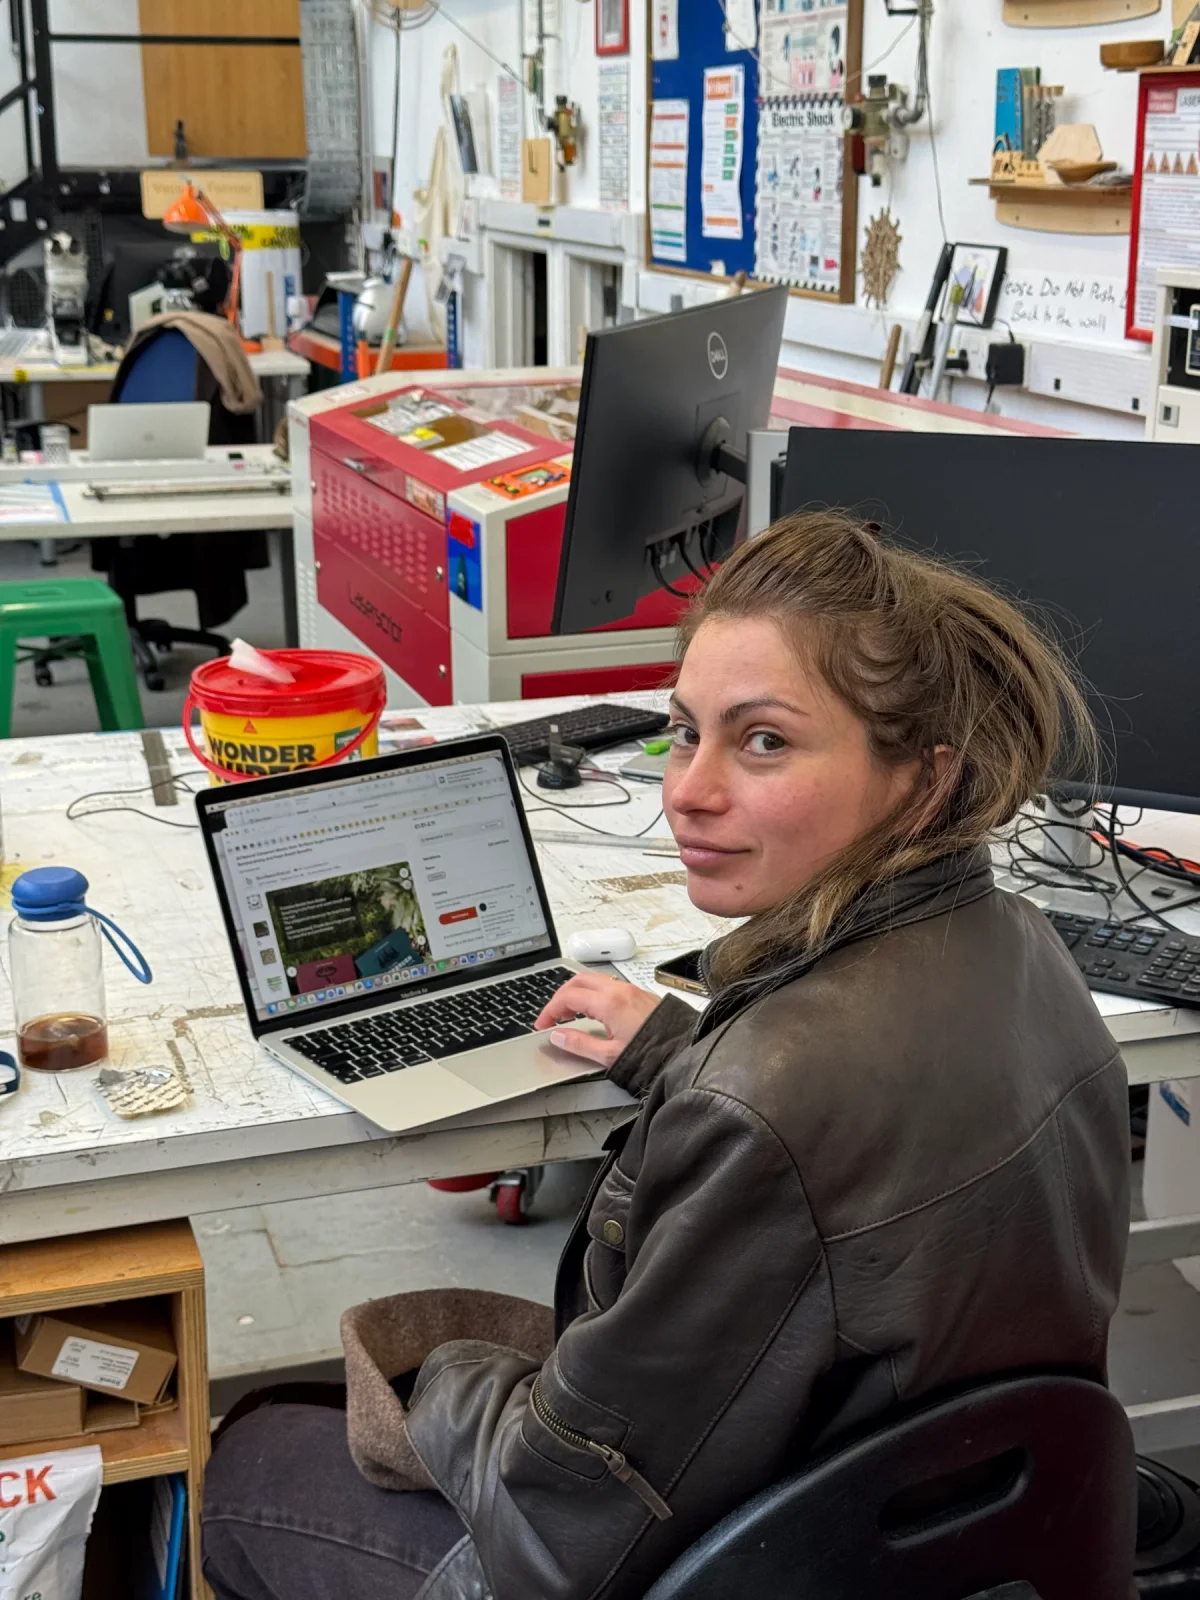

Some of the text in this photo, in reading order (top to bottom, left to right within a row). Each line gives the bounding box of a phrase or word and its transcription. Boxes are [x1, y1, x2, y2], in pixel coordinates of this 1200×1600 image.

[772, 111, 834, 128] Electric Shock
[1040, 278, 1060, 297] Do
[1065, 281, 1085, 298] Not
[1089, 282, 1116, 302] Push
[1080, 312, 1107, 333] wall
[208, 735, 317, 763] WONDER
